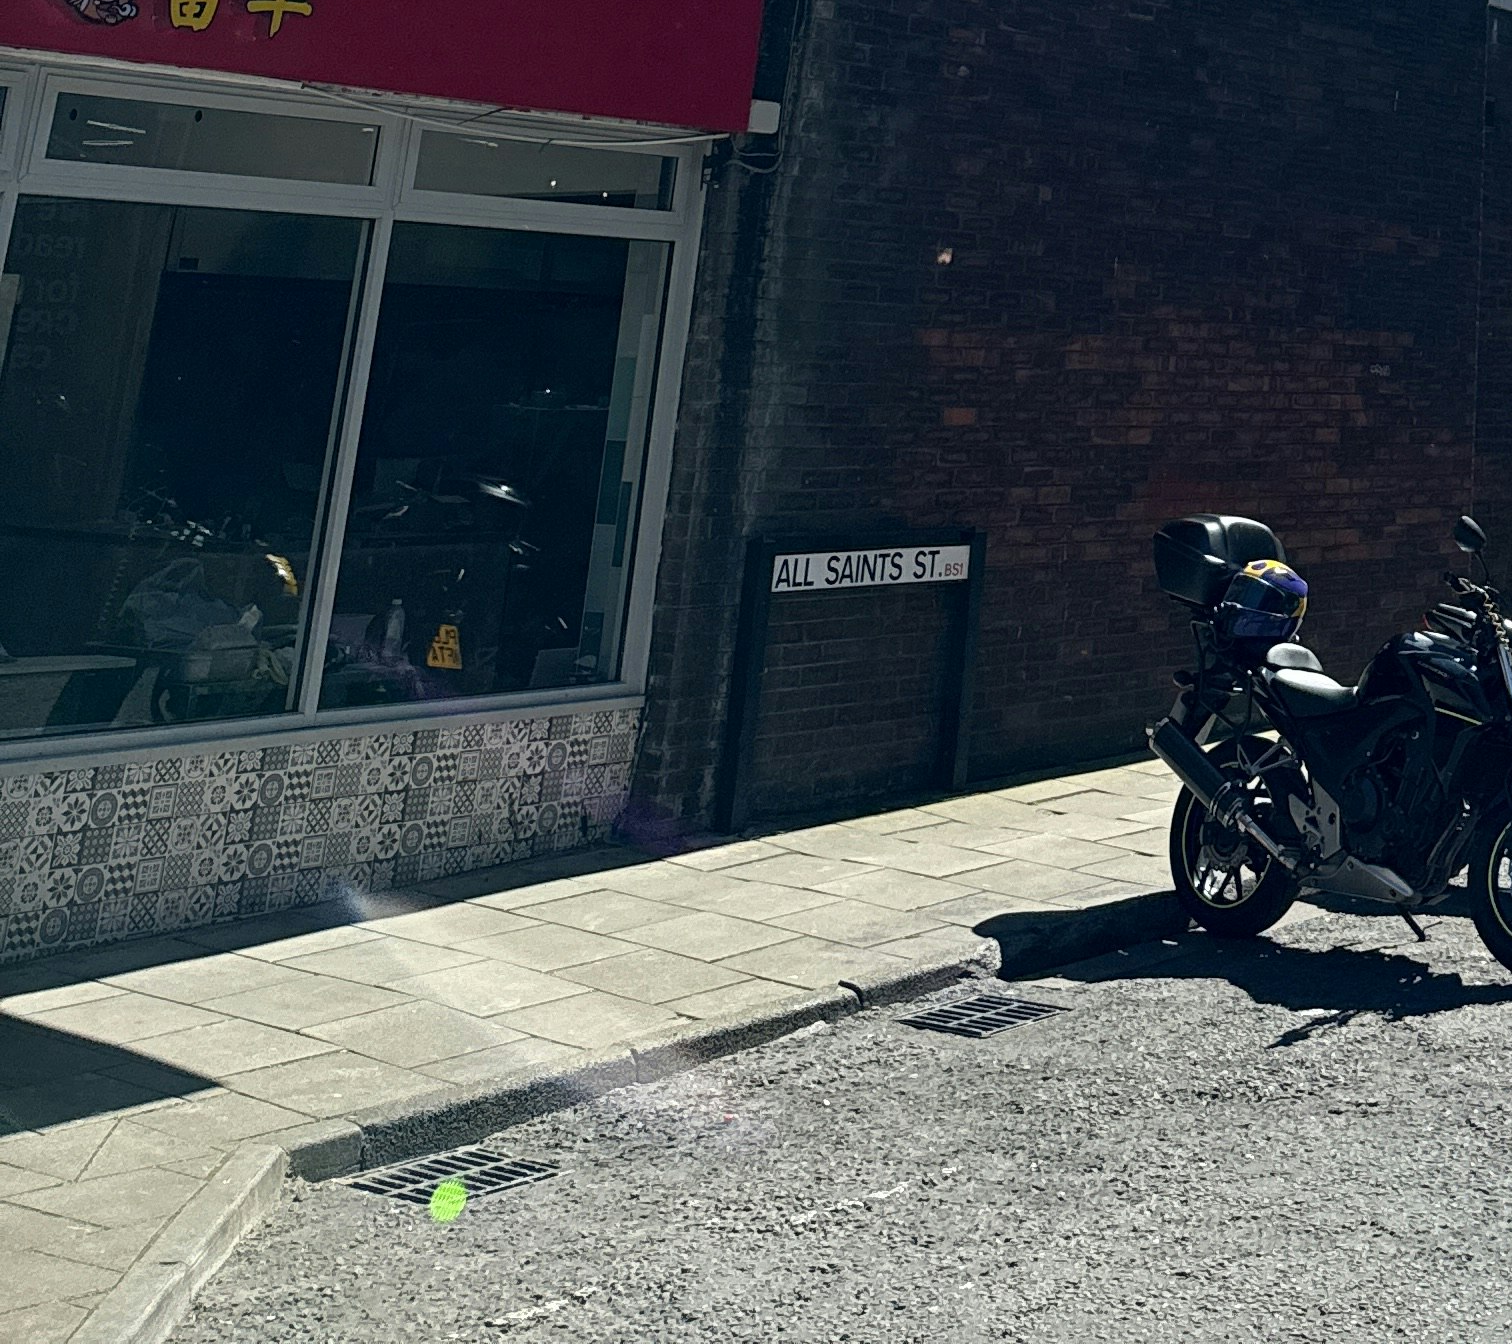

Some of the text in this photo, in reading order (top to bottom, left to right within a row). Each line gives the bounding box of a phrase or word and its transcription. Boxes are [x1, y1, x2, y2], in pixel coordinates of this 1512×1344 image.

[774, 549, 965, 589] ALL SAINTS ST. BS1
